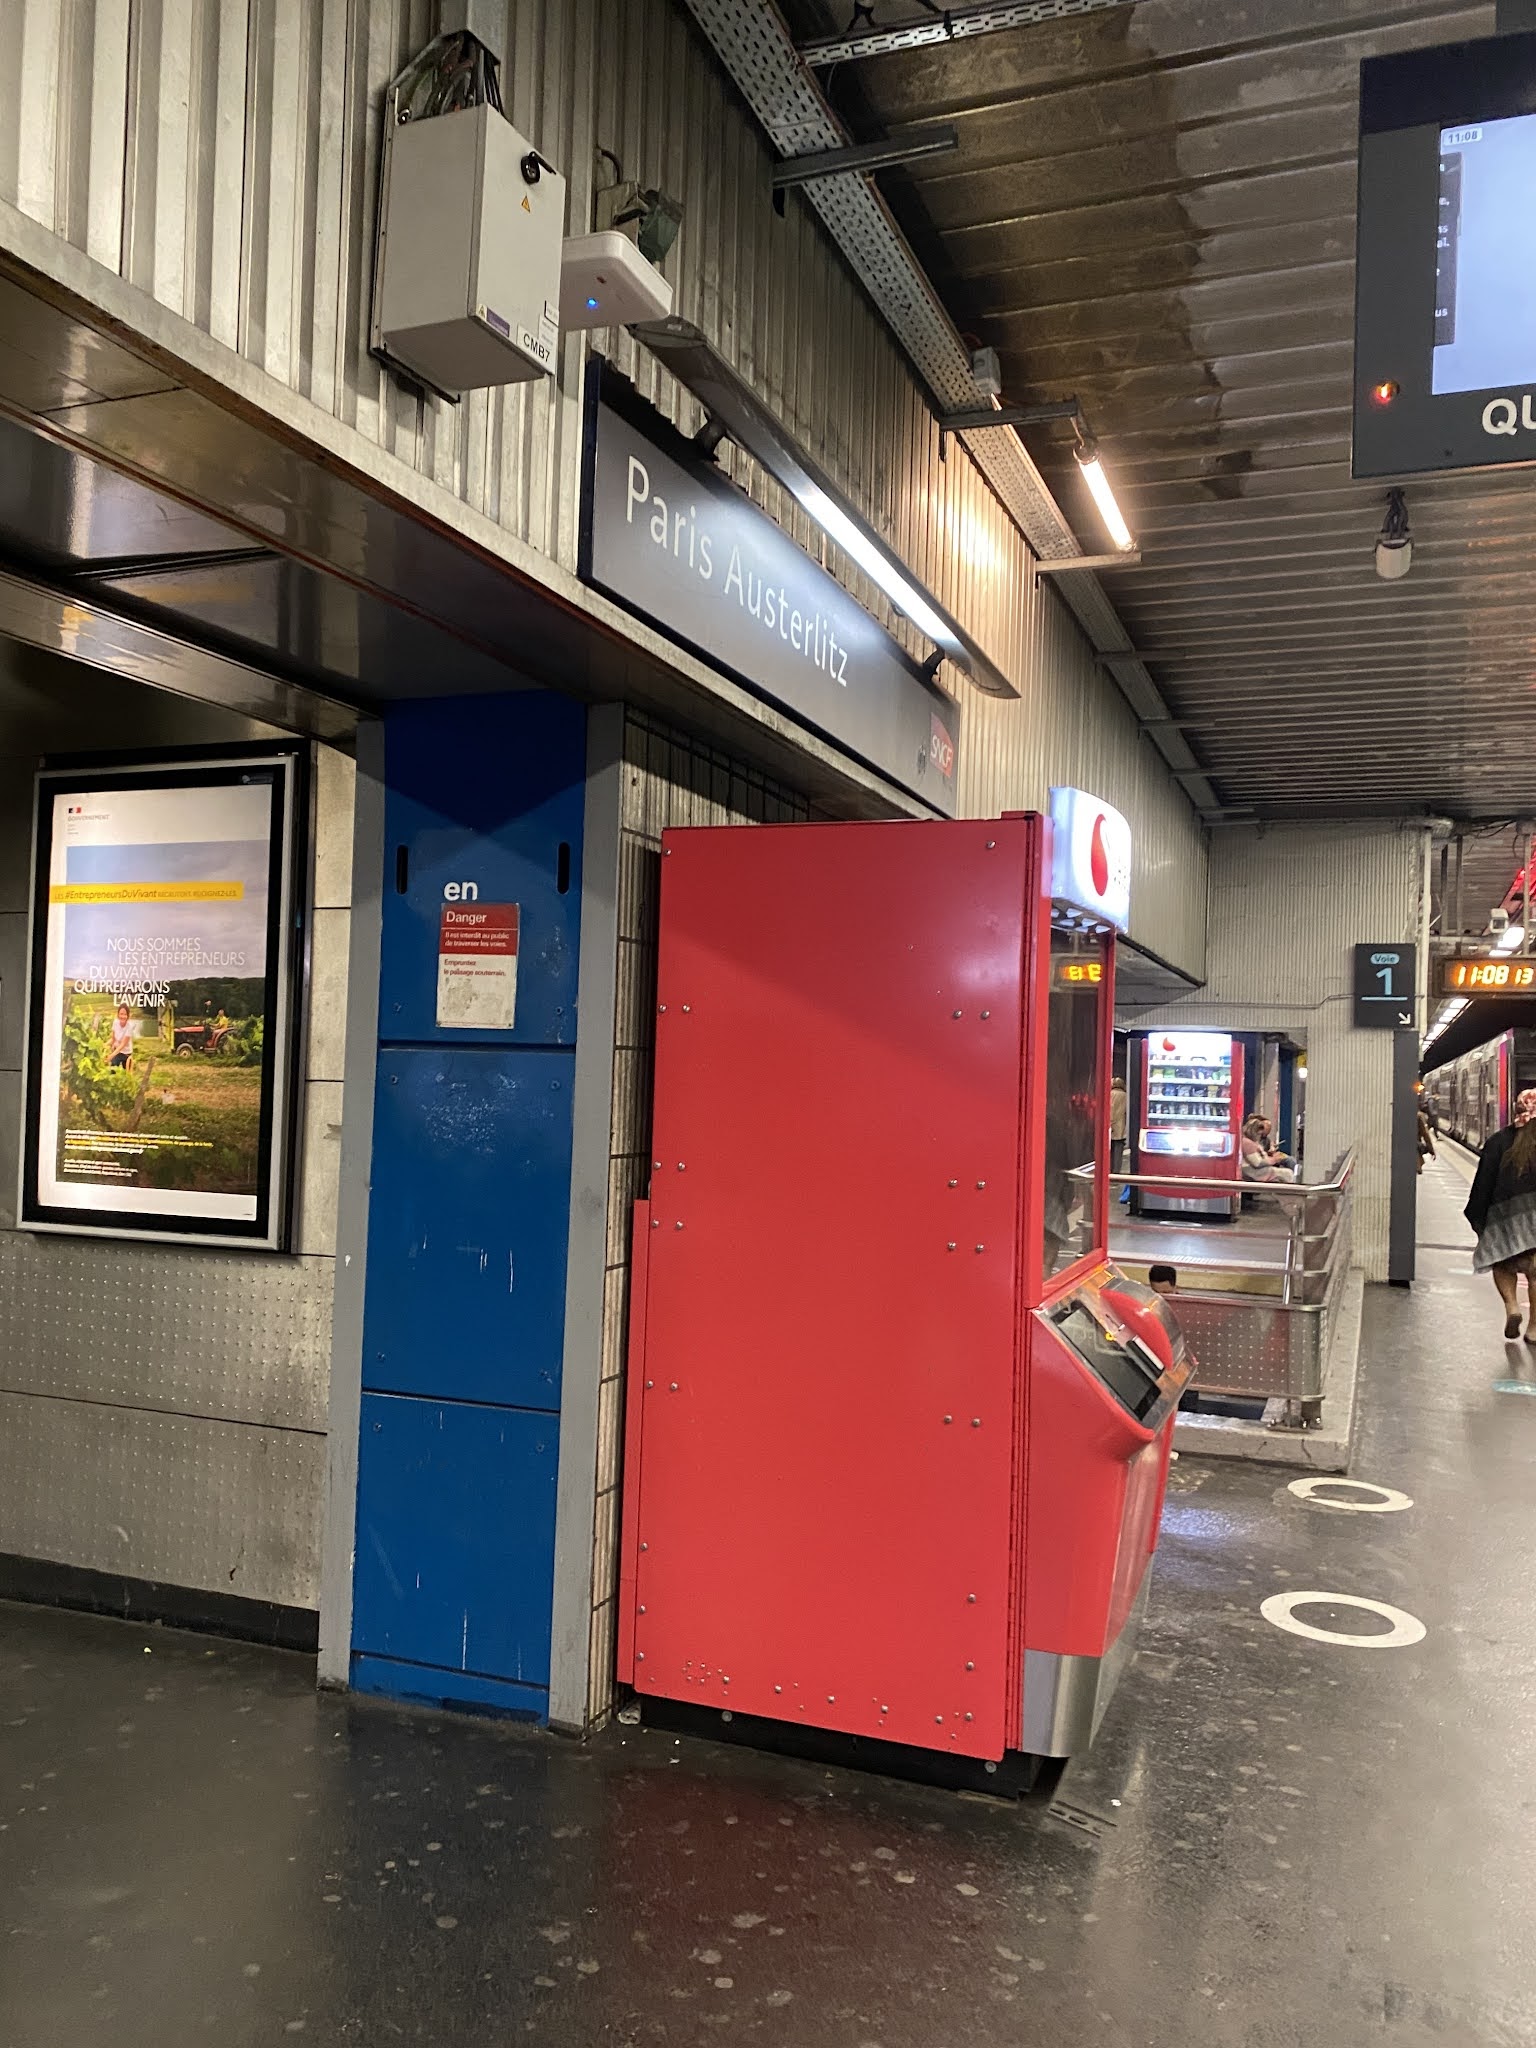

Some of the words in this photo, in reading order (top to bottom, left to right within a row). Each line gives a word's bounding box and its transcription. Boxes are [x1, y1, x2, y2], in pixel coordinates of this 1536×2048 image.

[1448, 129, 1478, 144] 11:08
[523, 333, 551, 362] CMB7
[626, 455, 714, 580] Paris
[724, 543, 848, 688] Austerlitz
[930, 734, 953, 768] SNCF
[65, 889, 158, 901] #EntrepreneursDuVivant
[443, 881, 478, 901] en
[446, 910, 487, 926] Danger
[445, 939, 453, 947] de
[459, 931, 482, 939] interdit
[490, 932, 510, 940] public
[107, 938, 144, 951] NOUS
[147, 937, 201, 951] SOMMES
[118, 952, 139, 966] LES
[141, 951, 246, 966] ENTREPRENEURS
[1374, 954, 1396, 963] Voie
[89, 966, 108, 980] DU
[110, 965, 158, 979] VIVANT
[1457, 965, 1510, 986] 11:08
[1514, 967, 1534, 985] 13
[73, 979, 97, 995] QUI
[1375, 967, 1393, 996] 1
[113, 994, 166, 1008] L'AVENIR
